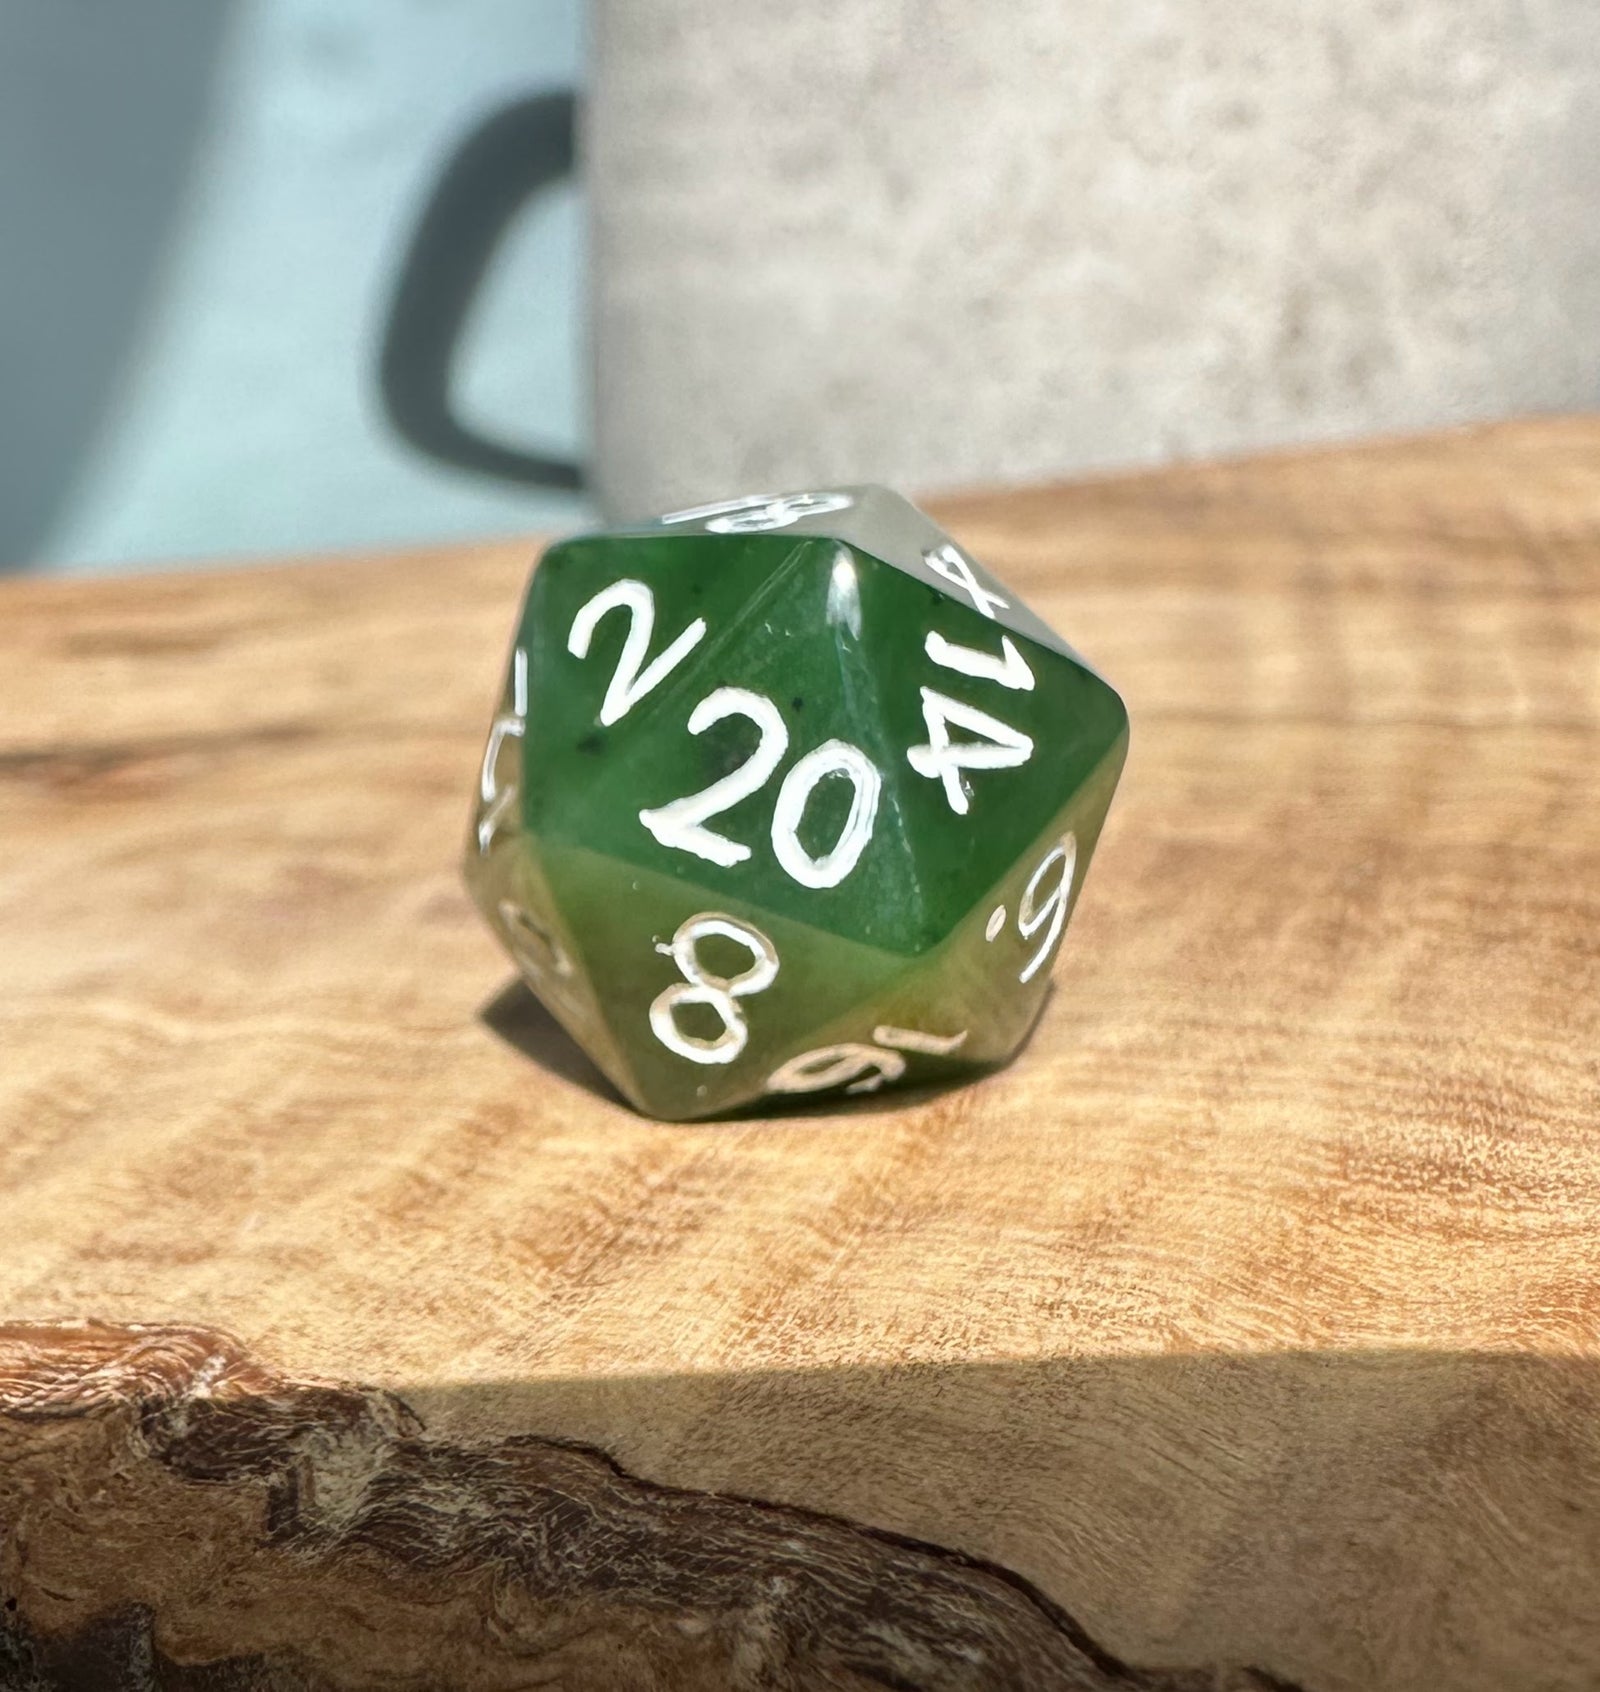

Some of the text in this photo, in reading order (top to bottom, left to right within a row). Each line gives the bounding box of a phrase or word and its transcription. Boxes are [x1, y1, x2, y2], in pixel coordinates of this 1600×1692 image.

[567, 577, 708, 727] 2
[906, 630, 1036, 816] 14
[639, 685, 882, 890] 20
[648, 910, 781, 1066] 8
